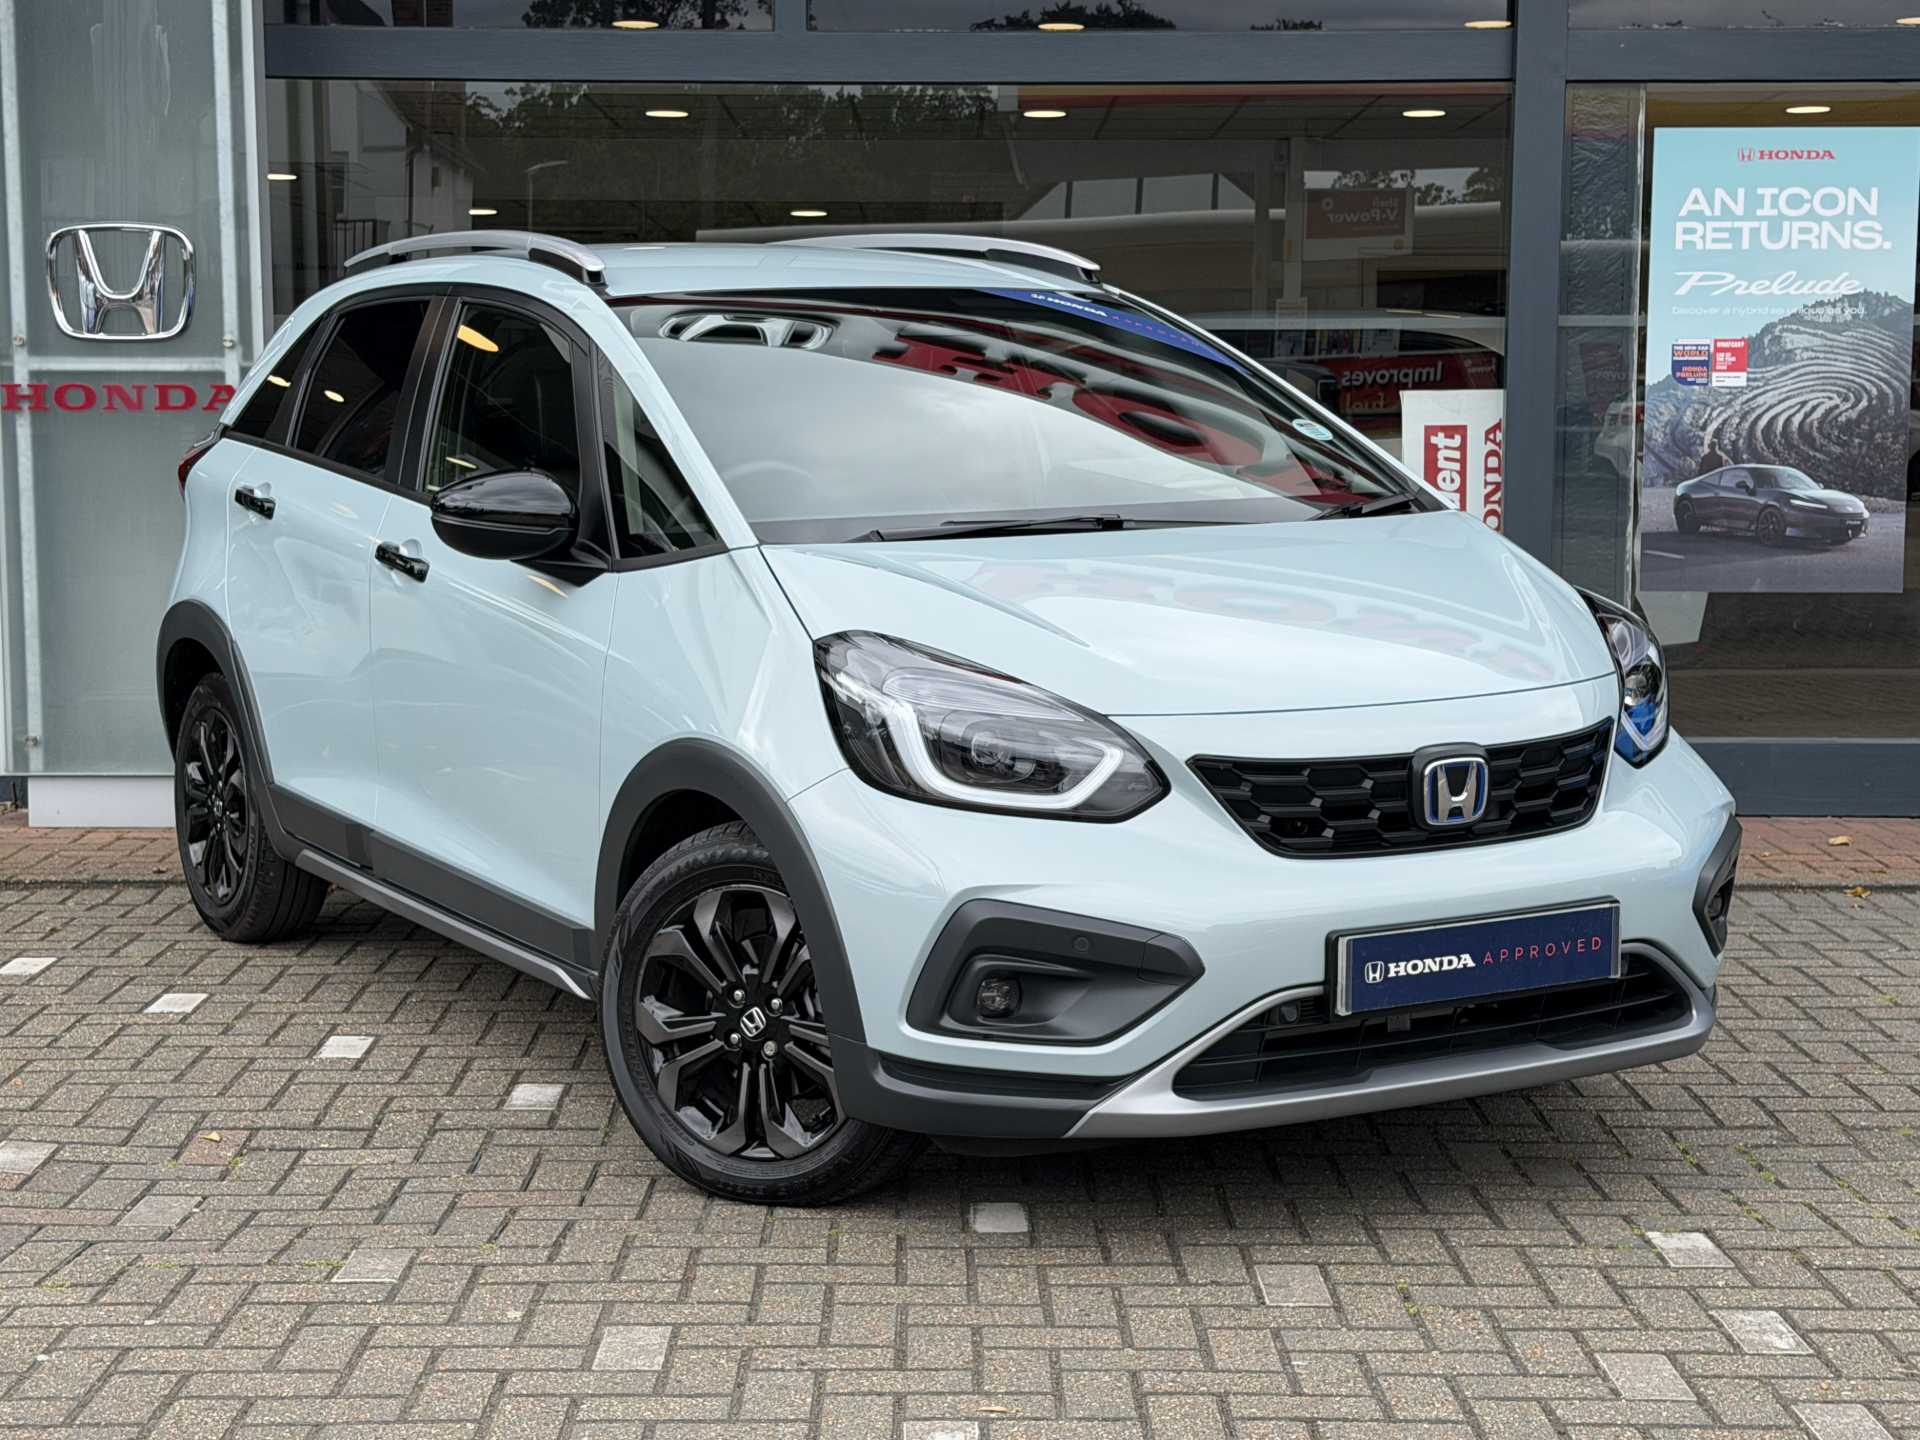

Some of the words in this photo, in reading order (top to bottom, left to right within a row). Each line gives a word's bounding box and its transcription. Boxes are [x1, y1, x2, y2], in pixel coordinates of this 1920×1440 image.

[1758, 149, 1836, 160] HONDA
[1678, 187, 1745, 217] AN
[1756, 186, 1879, 217] ICON
[1674, 220, 1892, 251] RETURNS.
[1673, 271, 1866, 296] Prelude
[1, 383, 237, 413] HONDA
[1482, 418, 1504, 533] ONDA
[1387, 953, 1477, 978] HONDA
[1482, 936, 1602, 967] APPROVED
